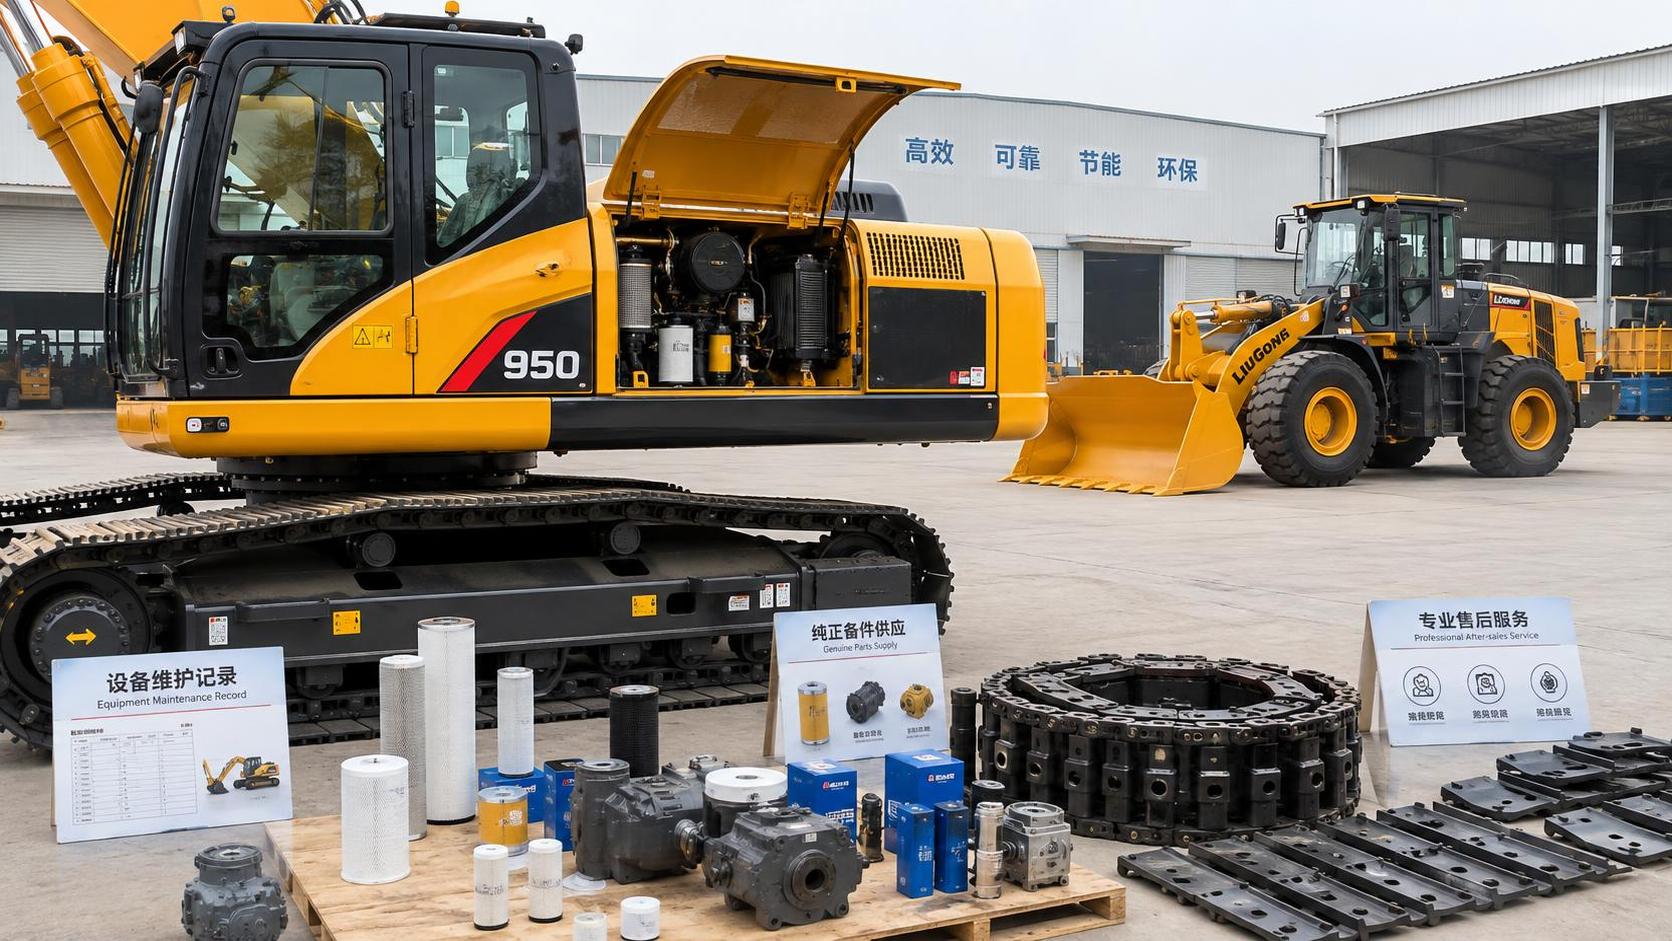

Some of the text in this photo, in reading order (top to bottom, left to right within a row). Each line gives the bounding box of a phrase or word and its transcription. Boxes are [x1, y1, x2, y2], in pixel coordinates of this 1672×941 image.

[905, 137, 1198, 183] 高效 可靠 节能 环保
[503, 350, 580, 379] 950
[811, 618, 906, 642] 纯正备件供应
[1418, 610, 1529, 630] 专业售后服务
[823, 641, 898, 653] Genuine Parts Supply
[1414, 631, 1539, 642] Professional After-sales Service
[106, 665, 238, 694] 设备维护记录
[97, 690, 247, 711] Equipment Maintenance Record
